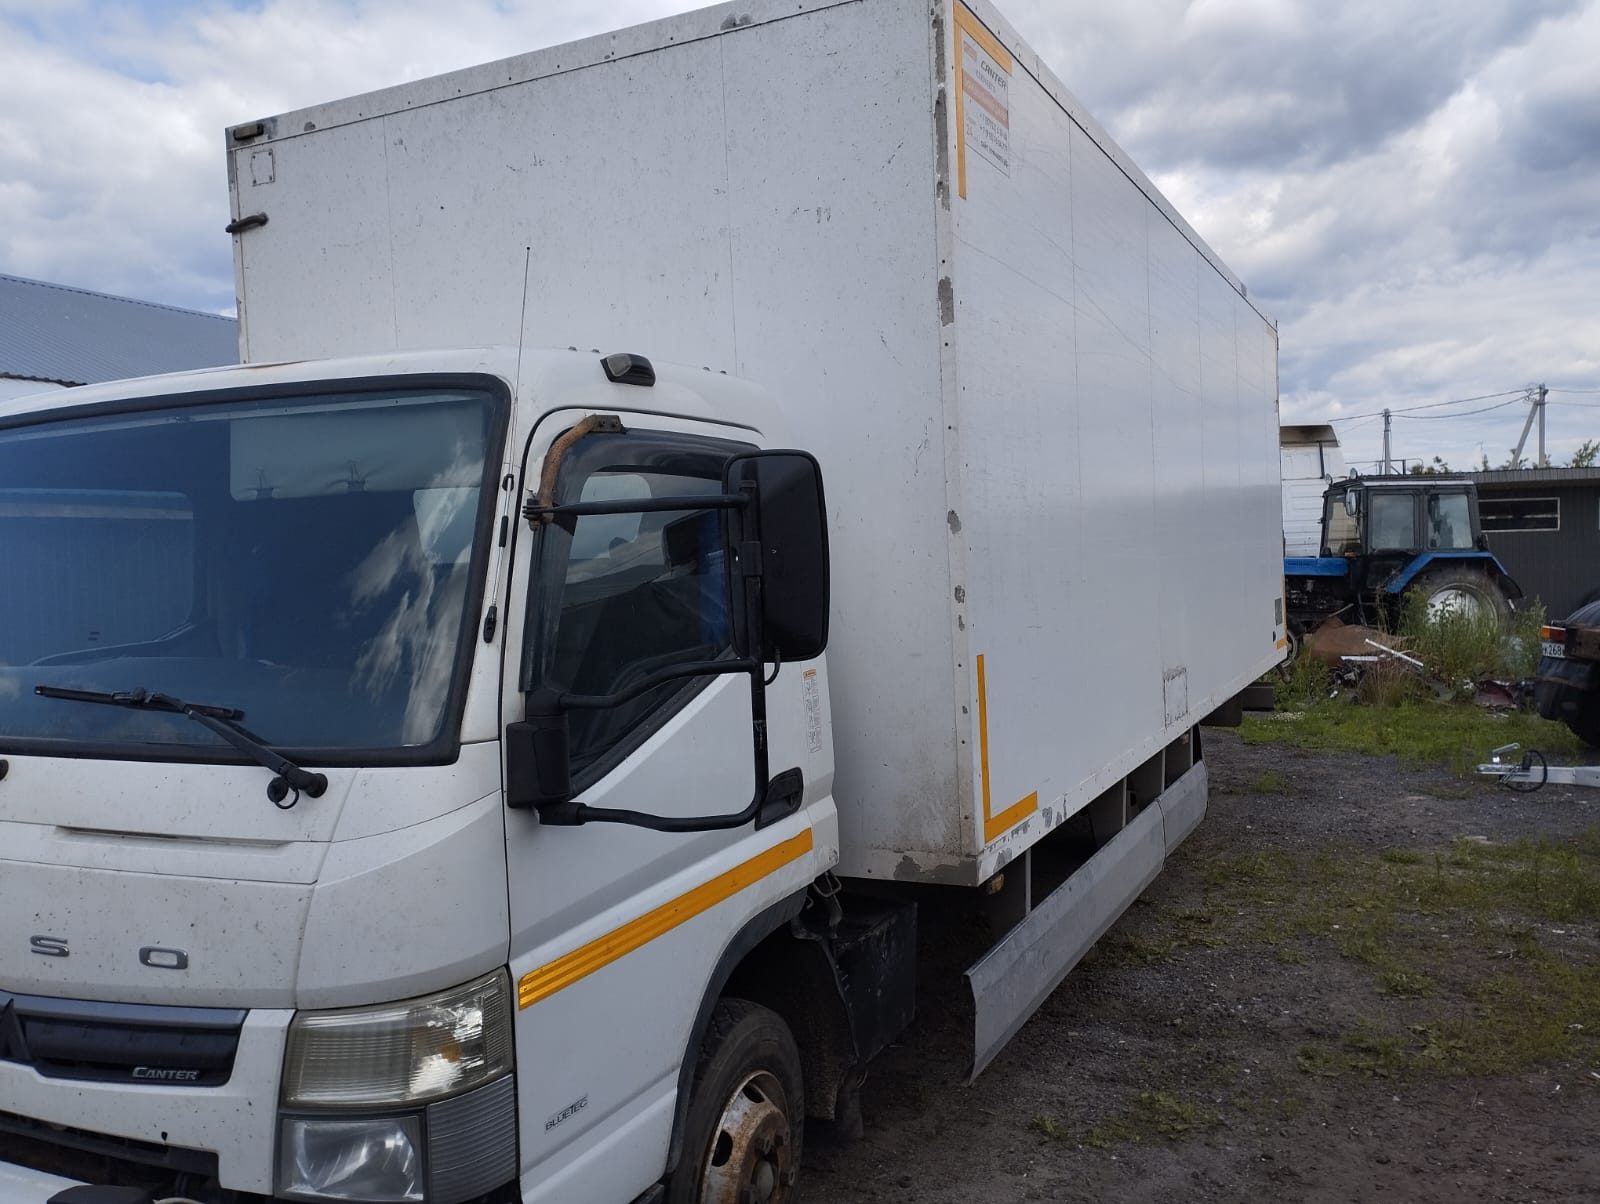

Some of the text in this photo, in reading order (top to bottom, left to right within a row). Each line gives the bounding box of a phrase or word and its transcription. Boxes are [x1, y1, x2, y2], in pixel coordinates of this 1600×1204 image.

[980, 60, 1007, 89] CANTER
[132, 1066, 199, 1080] CANTER
[545, 1097, 588, 1131] BLUETEC
